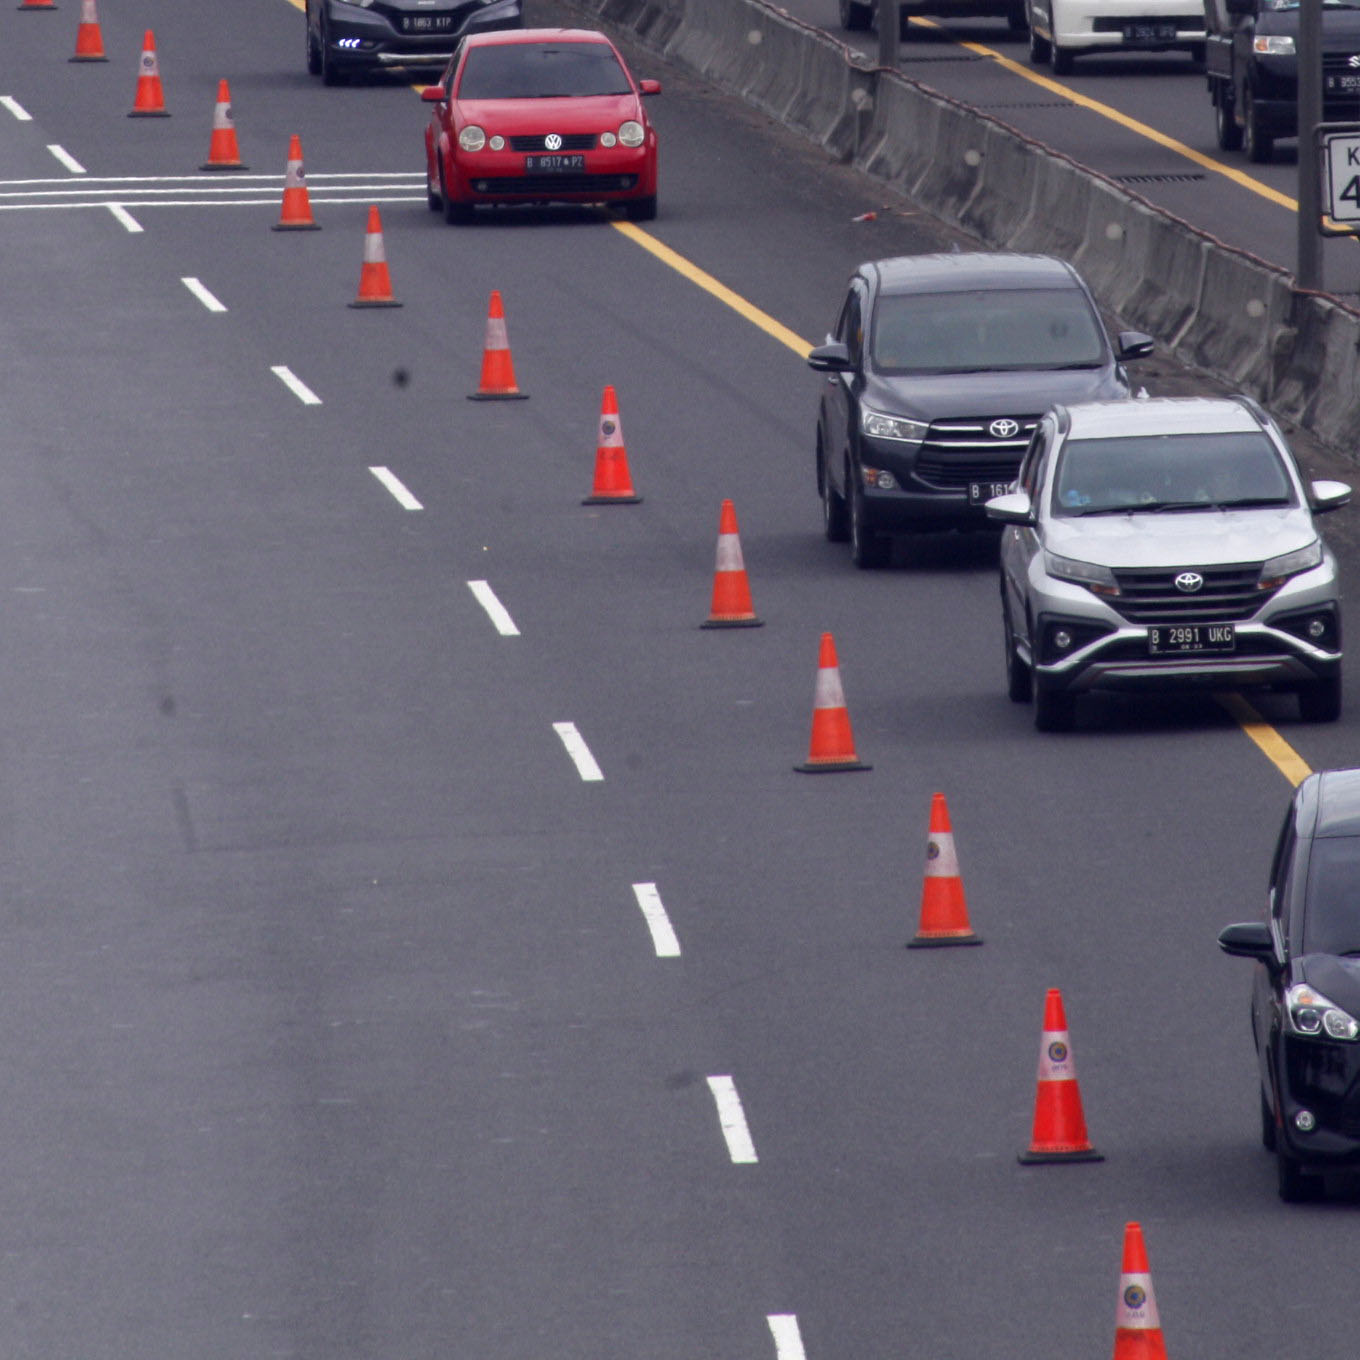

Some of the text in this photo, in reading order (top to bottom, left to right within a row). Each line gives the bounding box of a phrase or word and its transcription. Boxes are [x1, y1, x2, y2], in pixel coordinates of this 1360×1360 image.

[972, 483, 1009, 499] B 161
[1151, 626, 1232, 644] B 2991 UKG
